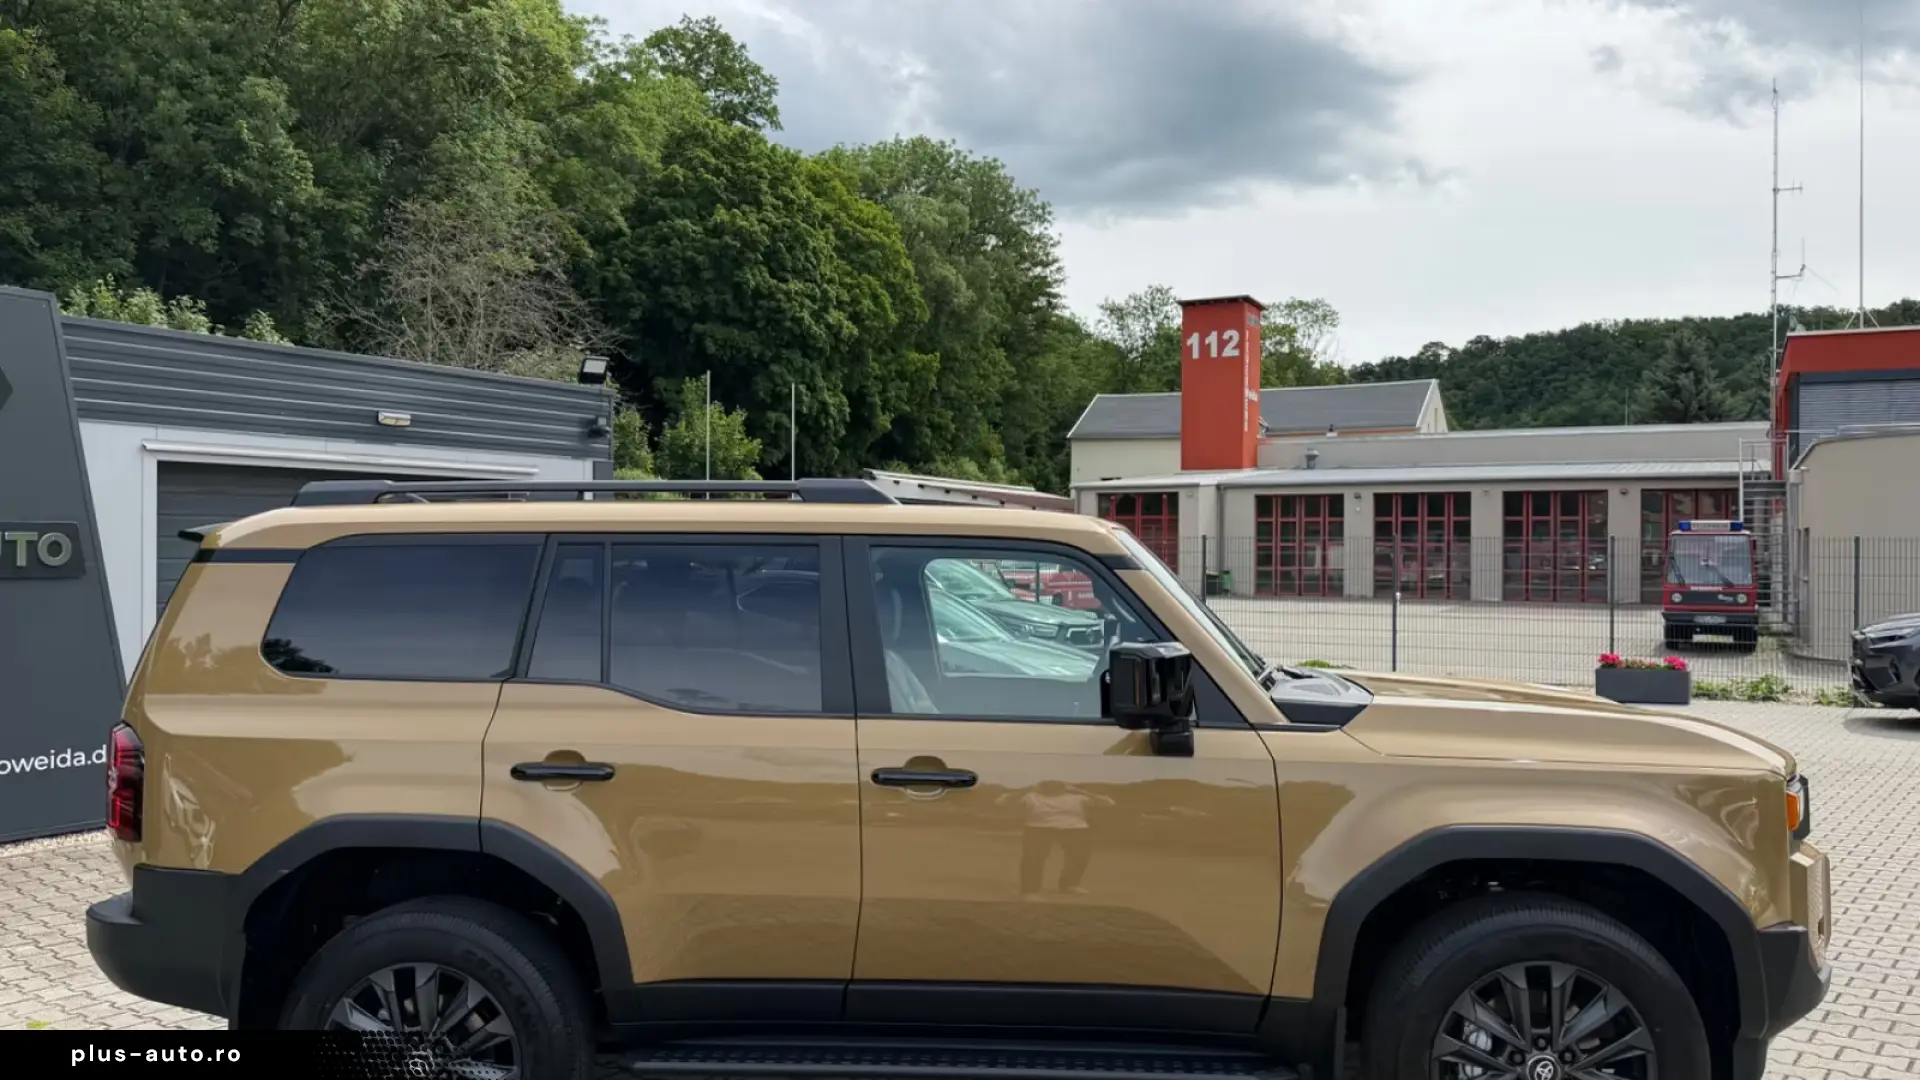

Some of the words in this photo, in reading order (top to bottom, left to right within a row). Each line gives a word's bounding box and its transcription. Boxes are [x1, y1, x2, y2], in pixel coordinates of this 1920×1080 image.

[1185, 328, 1241, 360] 112
[0, 531, 72, 567] TO
[0, 744, 107, 775] oweida.d
